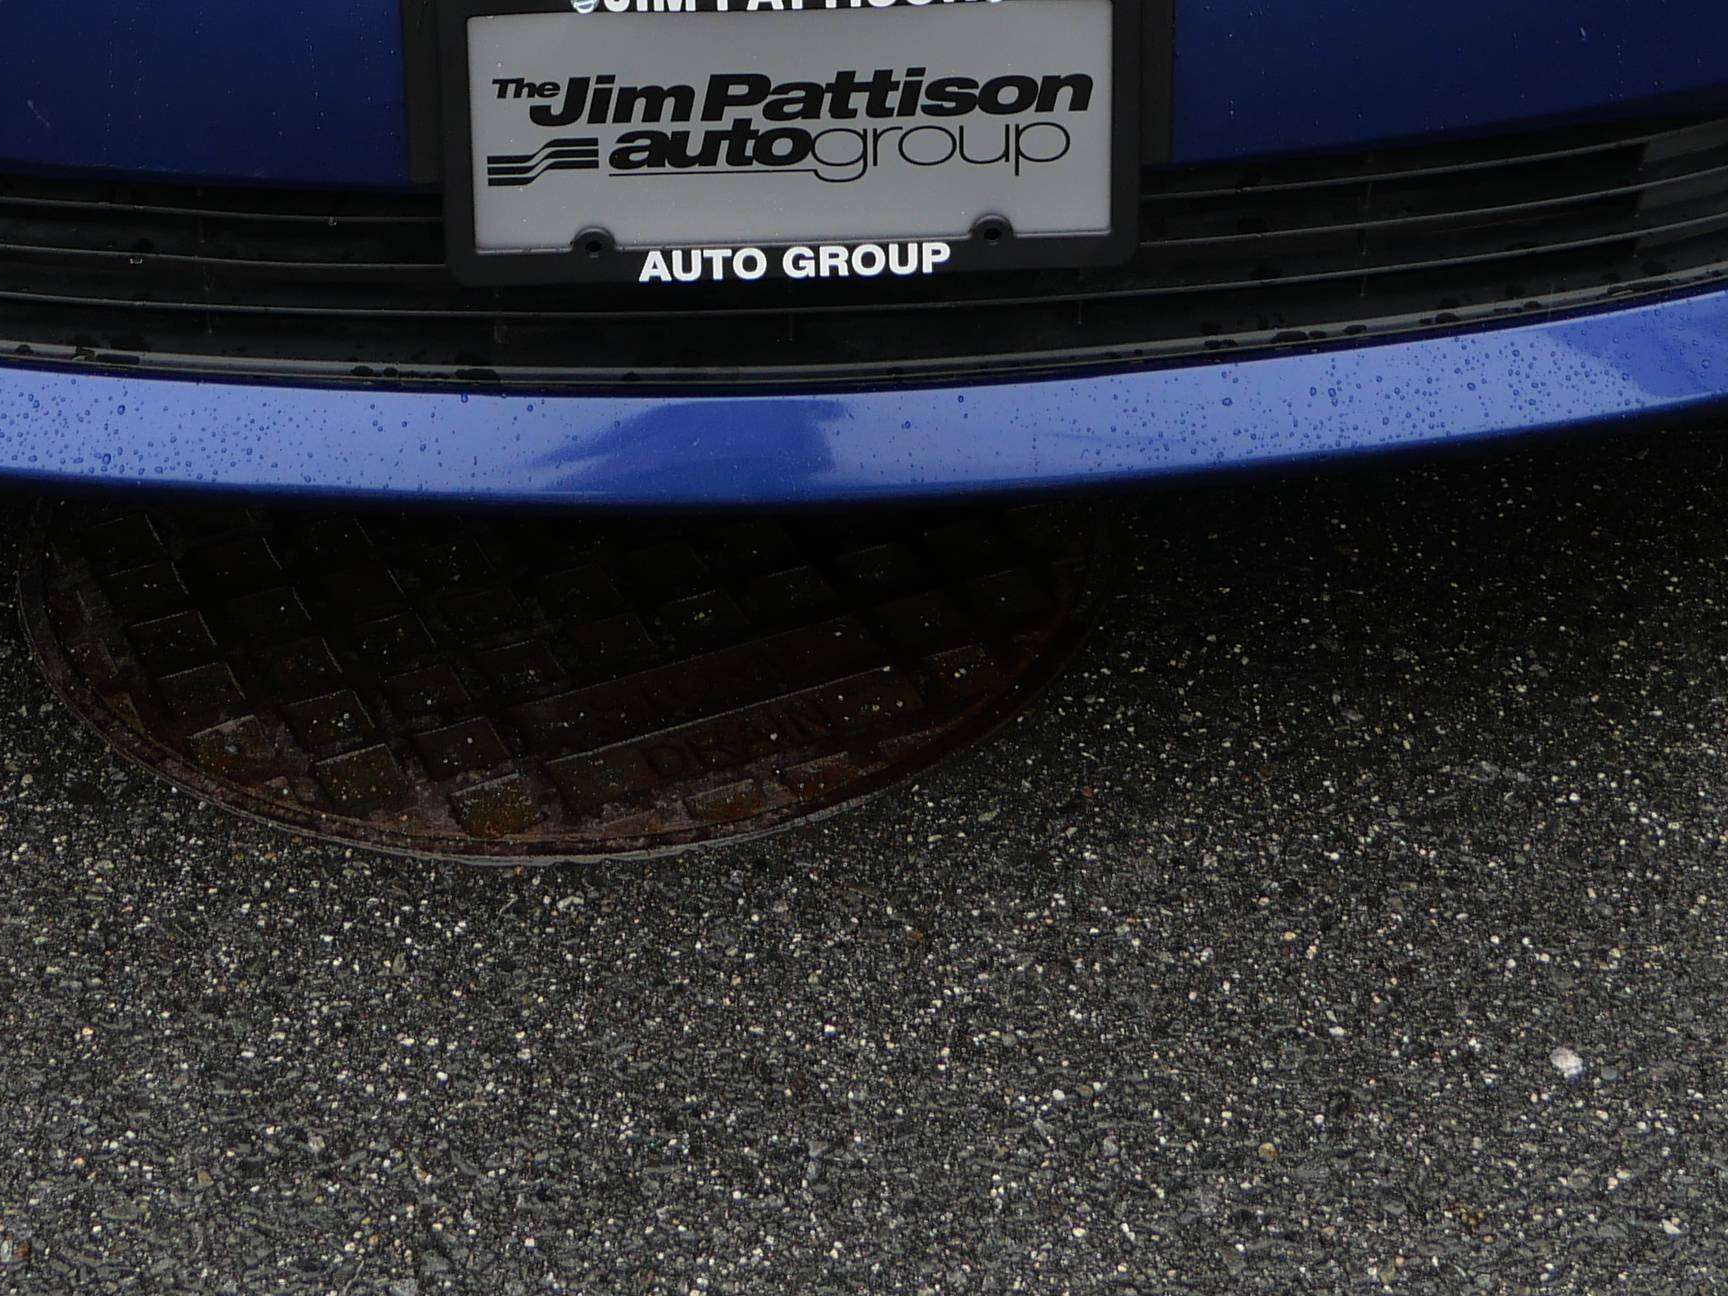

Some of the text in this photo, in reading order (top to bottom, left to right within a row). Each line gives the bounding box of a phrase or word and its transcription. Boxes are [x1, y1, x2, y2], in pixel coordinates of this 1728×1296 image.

[492, 66, 1095, 127] The Jim Pattison
[638, 242, 952, 283] AUTO GROUP
